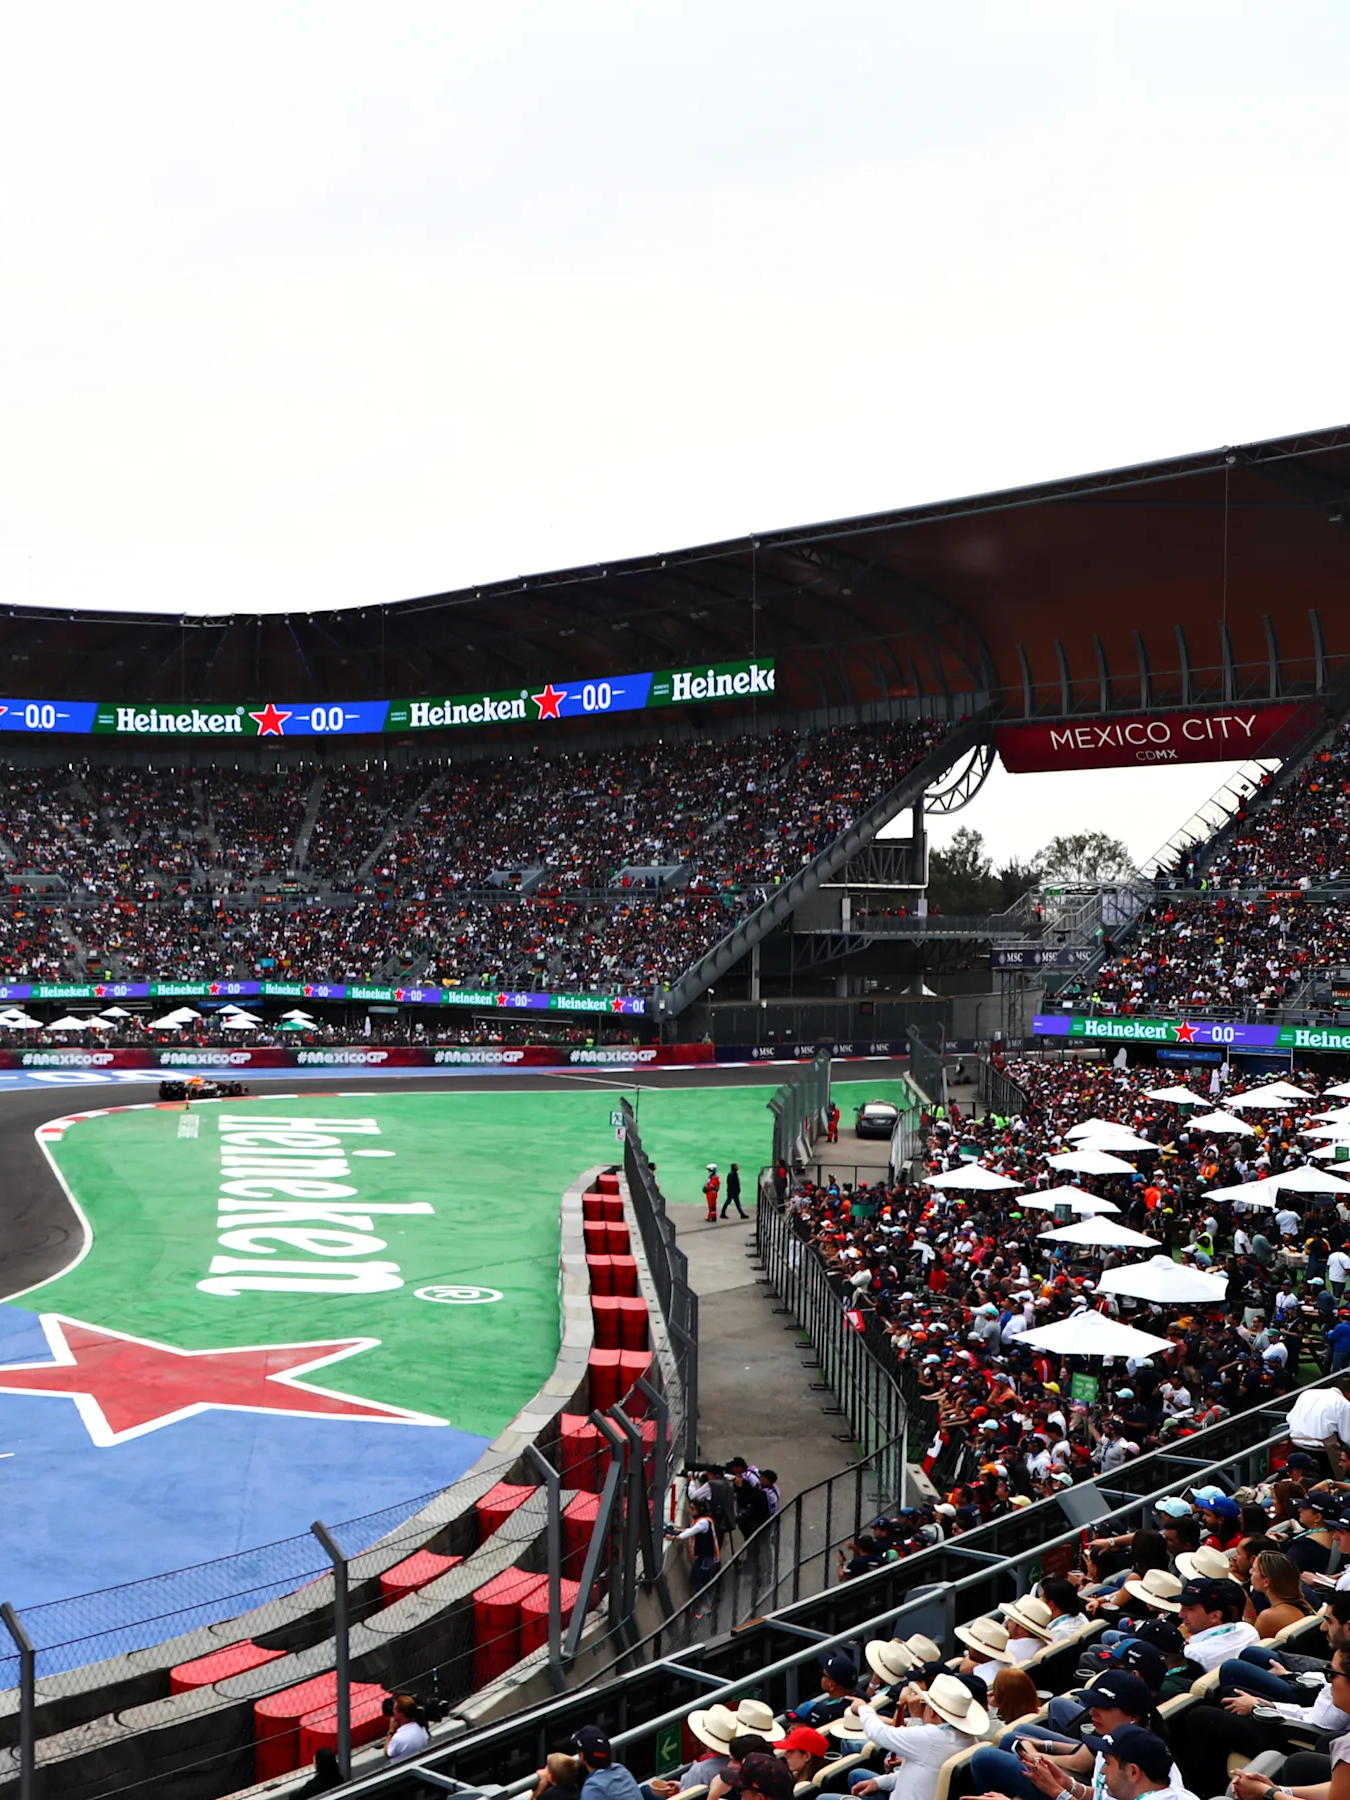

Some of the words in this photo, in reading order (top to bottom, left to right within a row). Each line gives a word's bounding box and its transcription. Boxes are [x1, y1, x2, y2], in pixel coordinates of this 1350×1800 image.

[1049, 721, 1171, 750] MEXICO
[1182, 714, 1257, 741] CITY
[1135, 749, 1178, 761] CDMX
[800, 1046, 814, 1054] MSC
[839, 1044, 853, 1052] MSC
[876, 1044, 889, 1052] MSC
[22, 1054, 114, 1065] #MexicoGP
[160, 1052, 252, 1064] #MexicoGP
[297, 1052, 388, 1063] #MexicoGP
[434, 1051, 524, 1062] #MexicoGP
[570, 1050, 657, 1062] #MexicoGP
